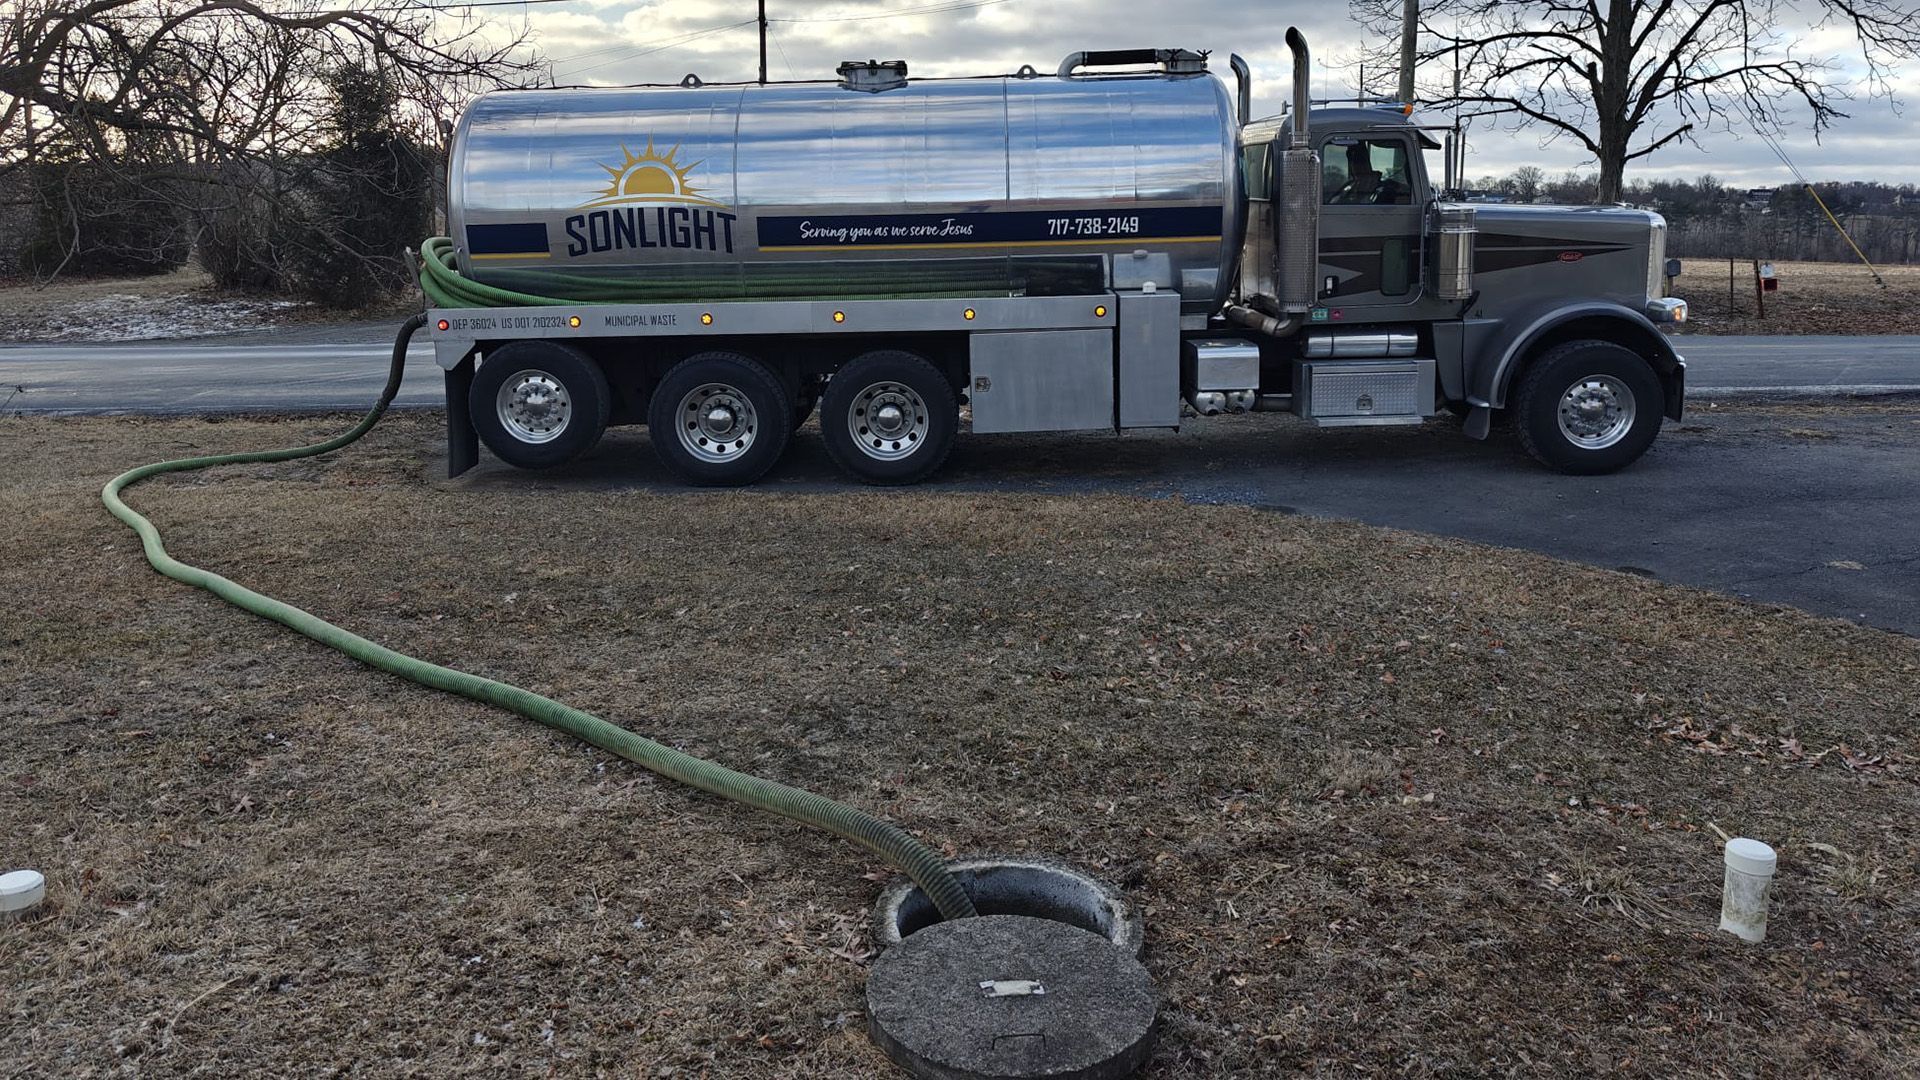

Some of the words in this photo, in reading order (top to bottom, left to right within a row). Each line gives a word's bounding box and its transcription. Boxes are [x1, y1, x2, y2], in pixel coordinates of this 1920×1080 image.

[565, 207, 737, 257] SONLIGHT
[799, 220, 848, 243] Serving
[849, 226, 873, 242] you
[874, 226, 889, 237] as
[891, 225, 908, 237] we
[909, 223, 940, 237] serve
[939, 218, 974, 237] Jesus
[1048, 217, 1139, 235] 717-738-2149
[452, 319, 468, 331] DEP
[470, 318, 497, 330] 36024
[501, 317, 513, 330] US
[515, 317, 530, 329] DOT
[533, 316, 566, 329] 2102324
[604, 315, 649, 328] MUNICIPAL
[650, 314, 677, 327] WASTE
